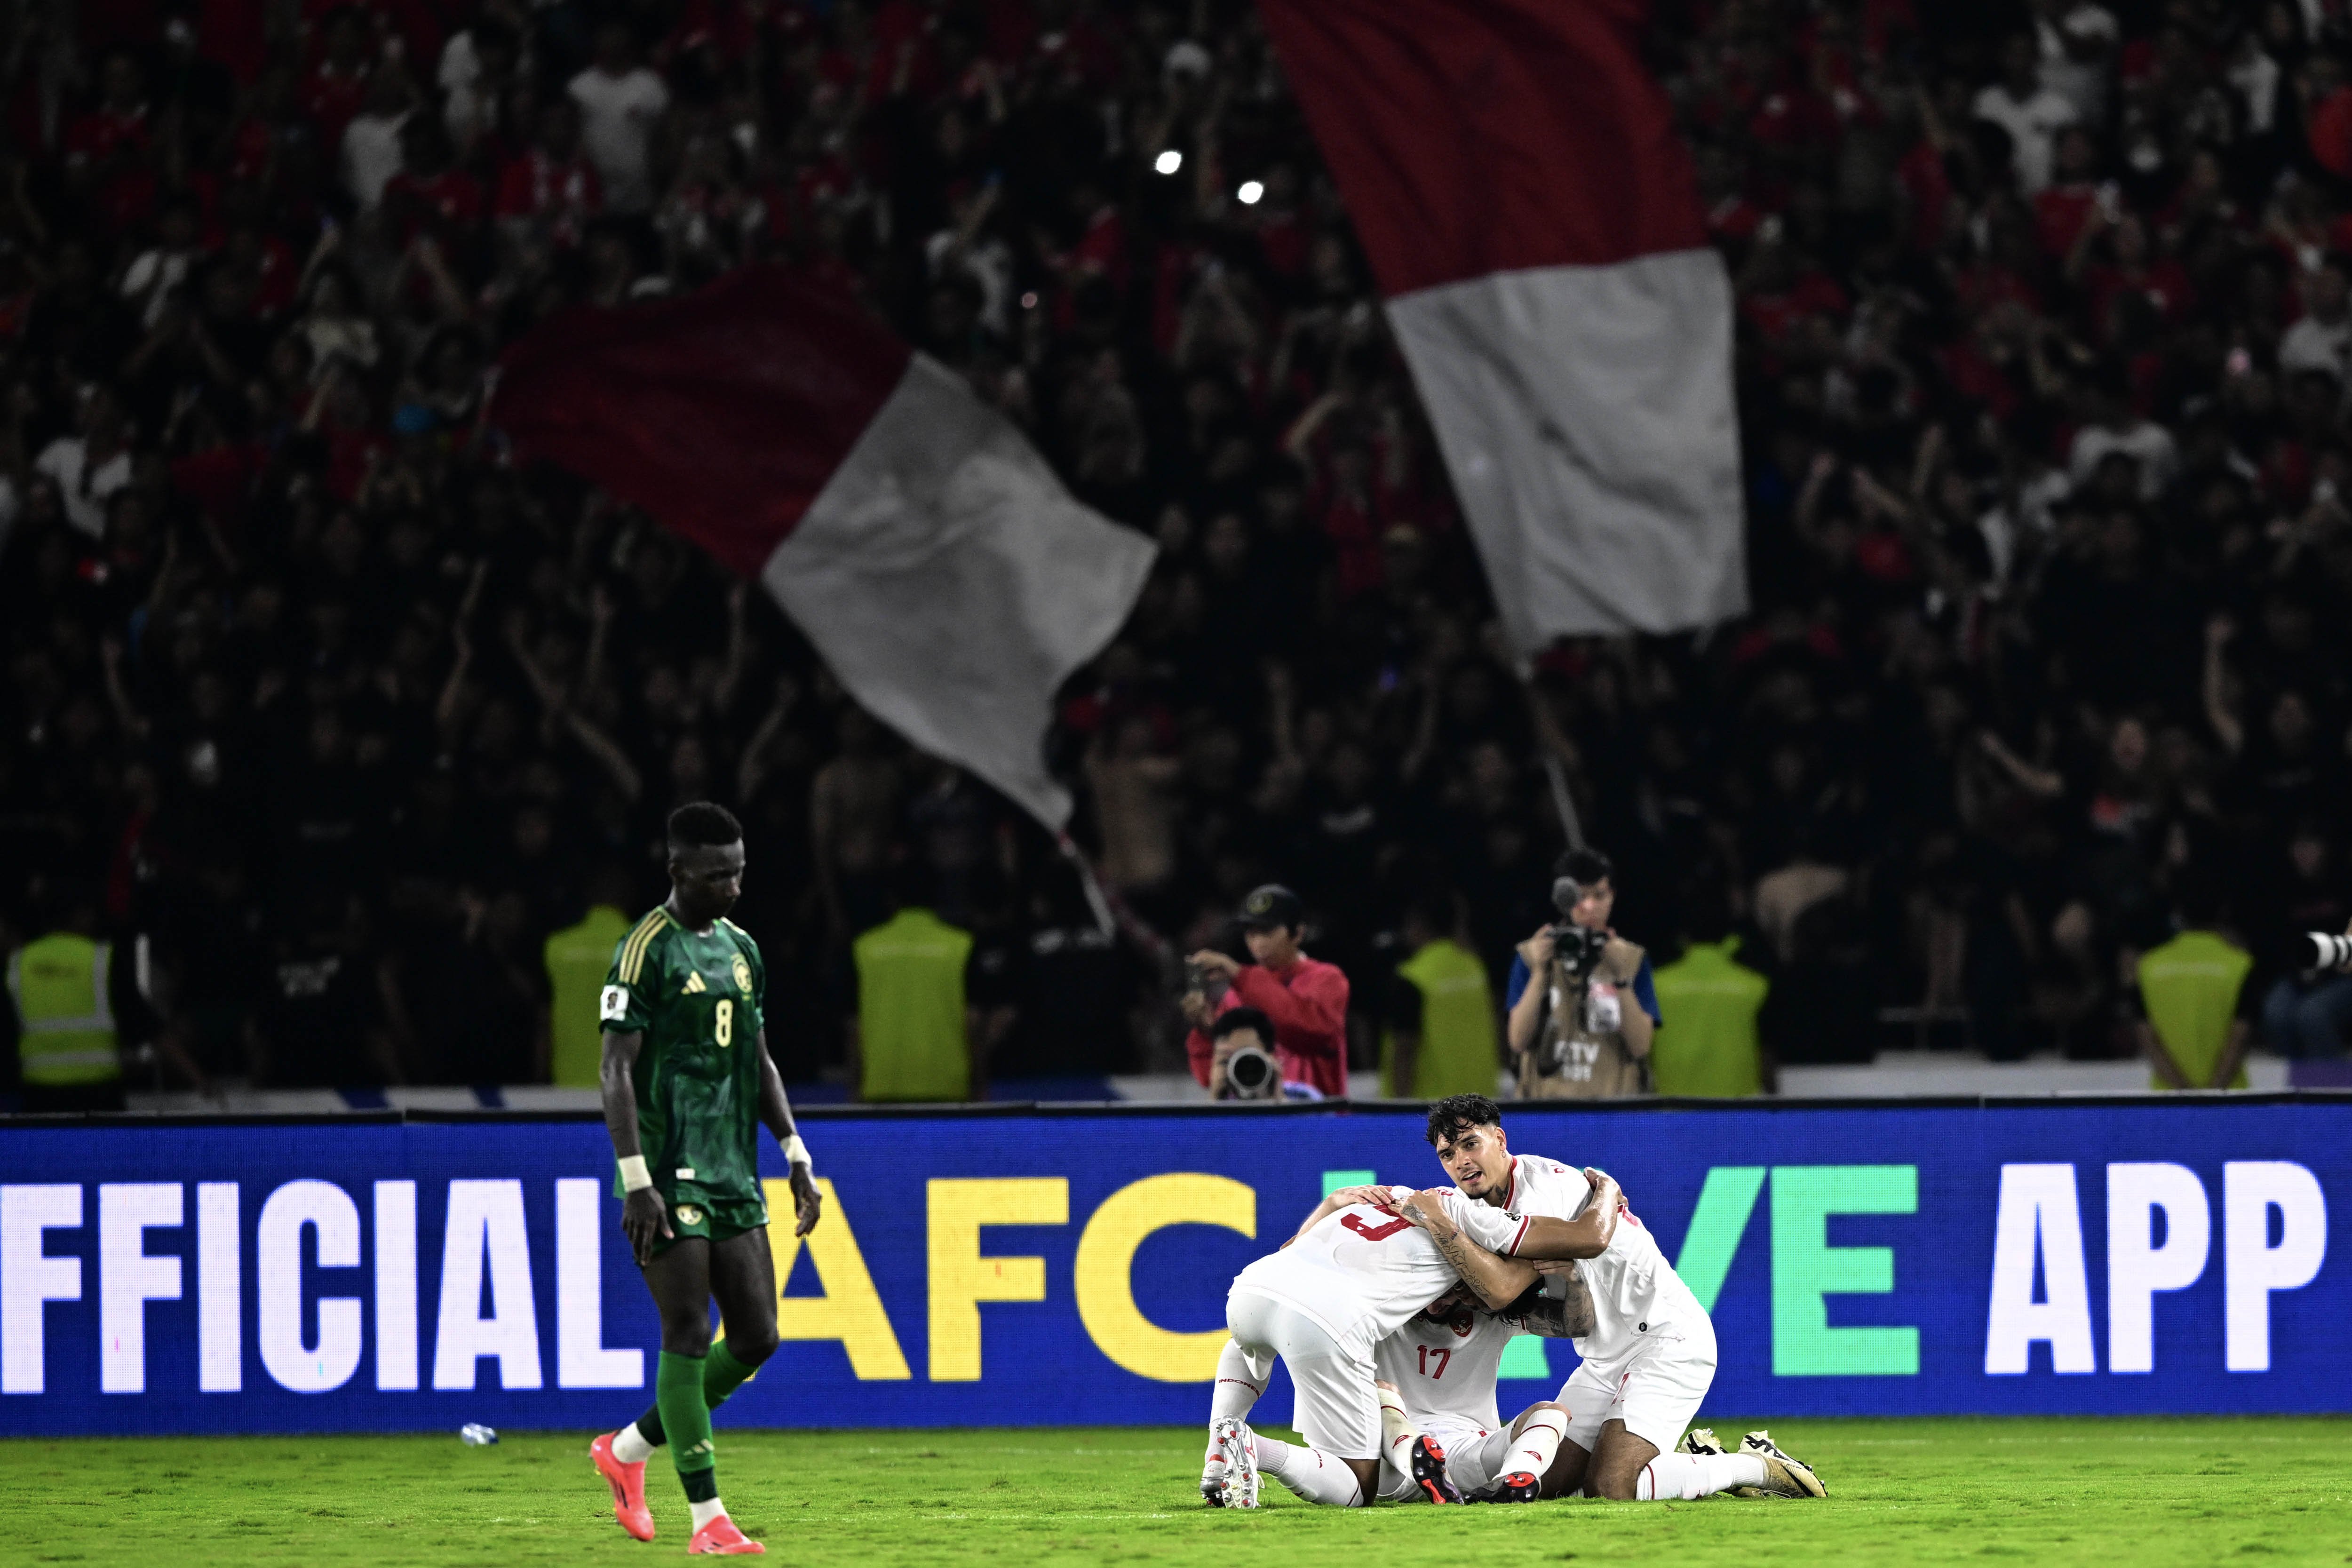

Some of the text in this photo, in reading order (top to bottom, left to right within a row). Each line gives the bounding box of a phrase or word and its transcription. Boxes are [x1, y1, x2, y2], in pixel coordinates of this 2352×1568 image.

[715, 998, 733, 1048] 8
[0, 1178, 644, 1393] FFICIAL
[713, 1172, 1257, 1382] AFC
[1984, 1161, 2328, 1375] APP
[1417, 1345, 1451, 1380] 17
